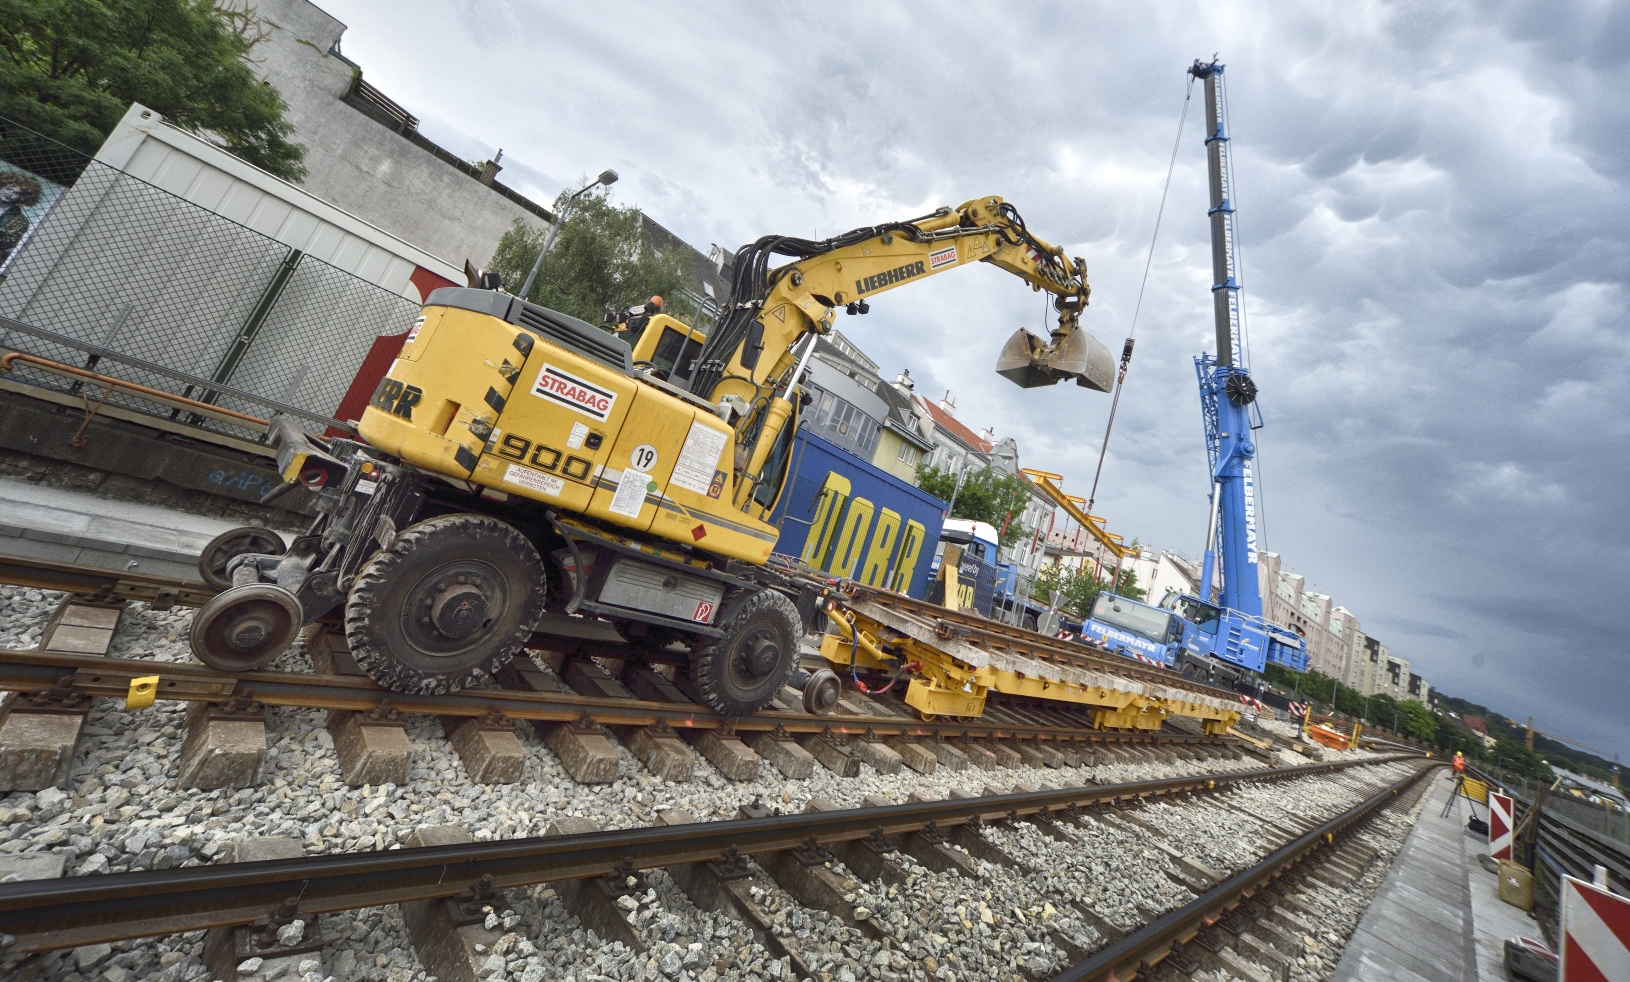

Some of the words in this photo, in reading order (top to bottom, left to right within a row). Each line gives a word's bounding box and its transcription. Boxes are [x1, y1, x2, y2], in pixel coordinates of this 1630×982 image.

[1219, 142, 1228, 199] FELBERMAYR
[930, 251, 956, 265] STRABAG
[1224, 215, 1234, 277] FELBERMAYR
[855, 260, 926, 295] LIEBHERR
[538, 374, 610, 411] STRABAG
[498, 433, 592, 482] 900
[637, 447, 654, 468] 19
[518, 480, 547, 492] VERBOTEN
[1243, 460, 1257, 563] FELBERMAYR
[1091, 624, 1156, 653] FELBERMAYR
